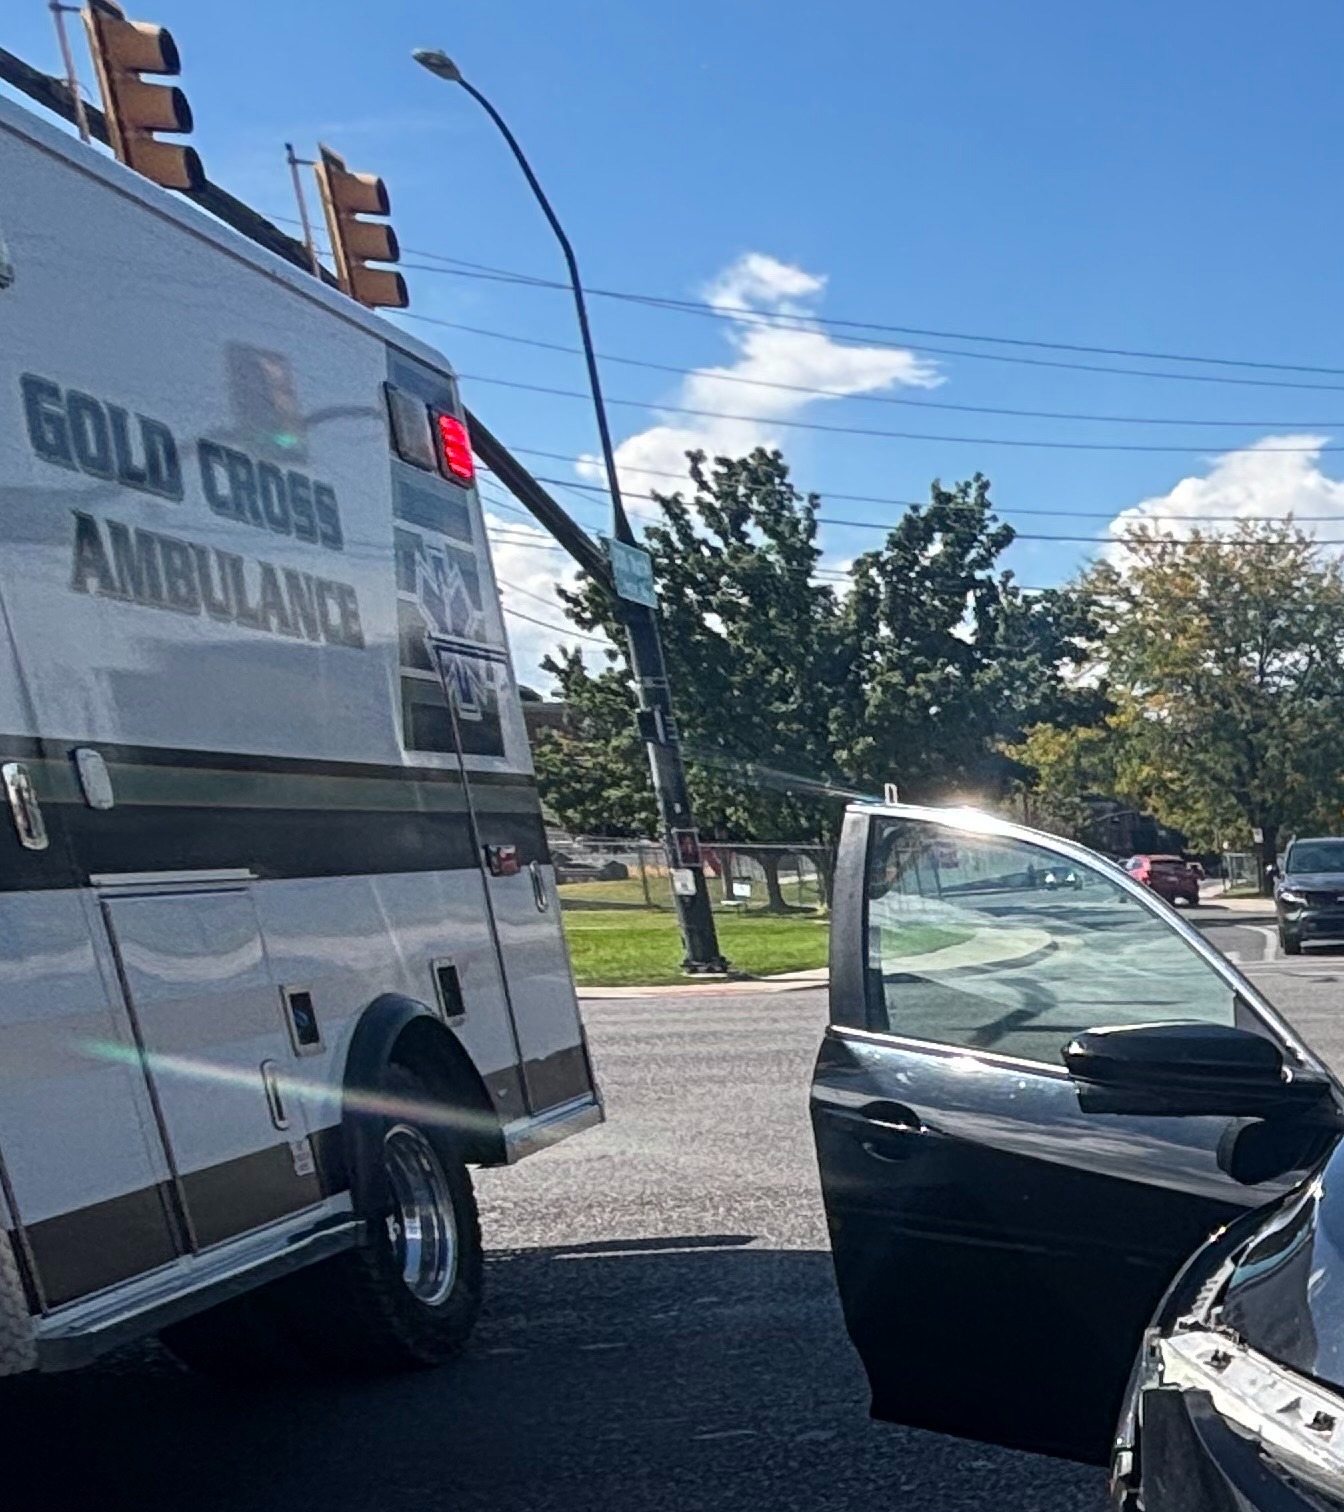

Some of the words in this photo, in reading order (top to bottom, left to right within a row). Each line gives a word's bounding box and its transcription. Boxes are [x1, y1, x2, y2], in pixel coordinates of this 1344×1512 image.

[20, 371, 184, 502] GOLD
[197, 437, 345, 551] CROSS
[71, 508, 365, 650] AMBULANCE
